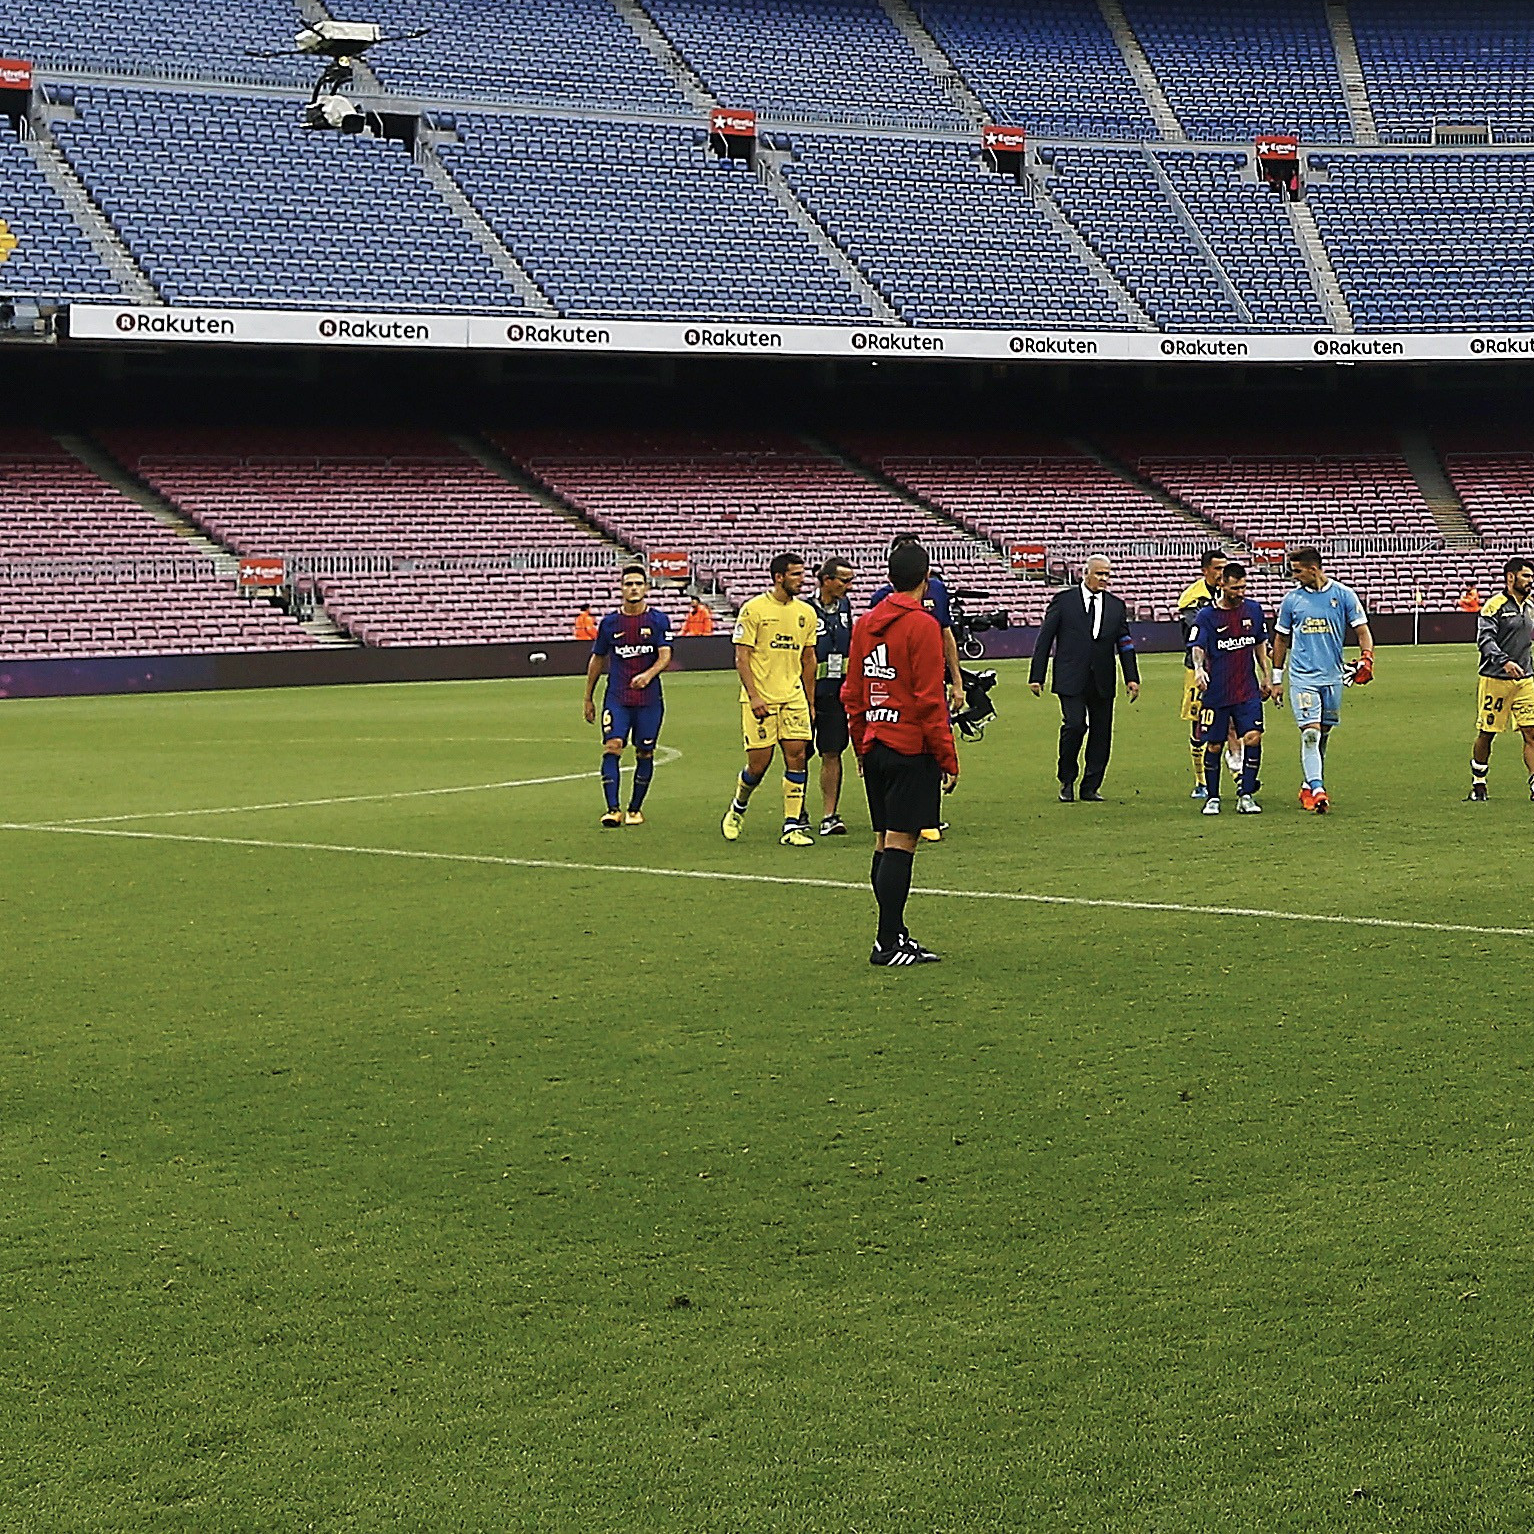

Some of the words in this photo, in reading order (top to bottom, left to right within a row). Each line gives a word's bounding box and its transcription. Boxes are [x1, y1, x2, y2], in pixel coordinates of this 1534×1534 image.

[137, 314, 235, 337] Rakuten
[338, 318, 430, 340] Rakuten
[525, 325, 611, 345] Rakuten
[701, 329, 782, 349] Rakuten
[869, 332, 945, 352] Rakuten
[1024, 336, 1098, 355] Rakuten
[1176, 338, 1248, 357] Rakuten
[1329, 338, 1404, 356] Rakuten
[1217, 636, 1255, 650] Rakuten
[1484, 695, 1503, 713] 24
[1200, 709, 1215, 725] 10
